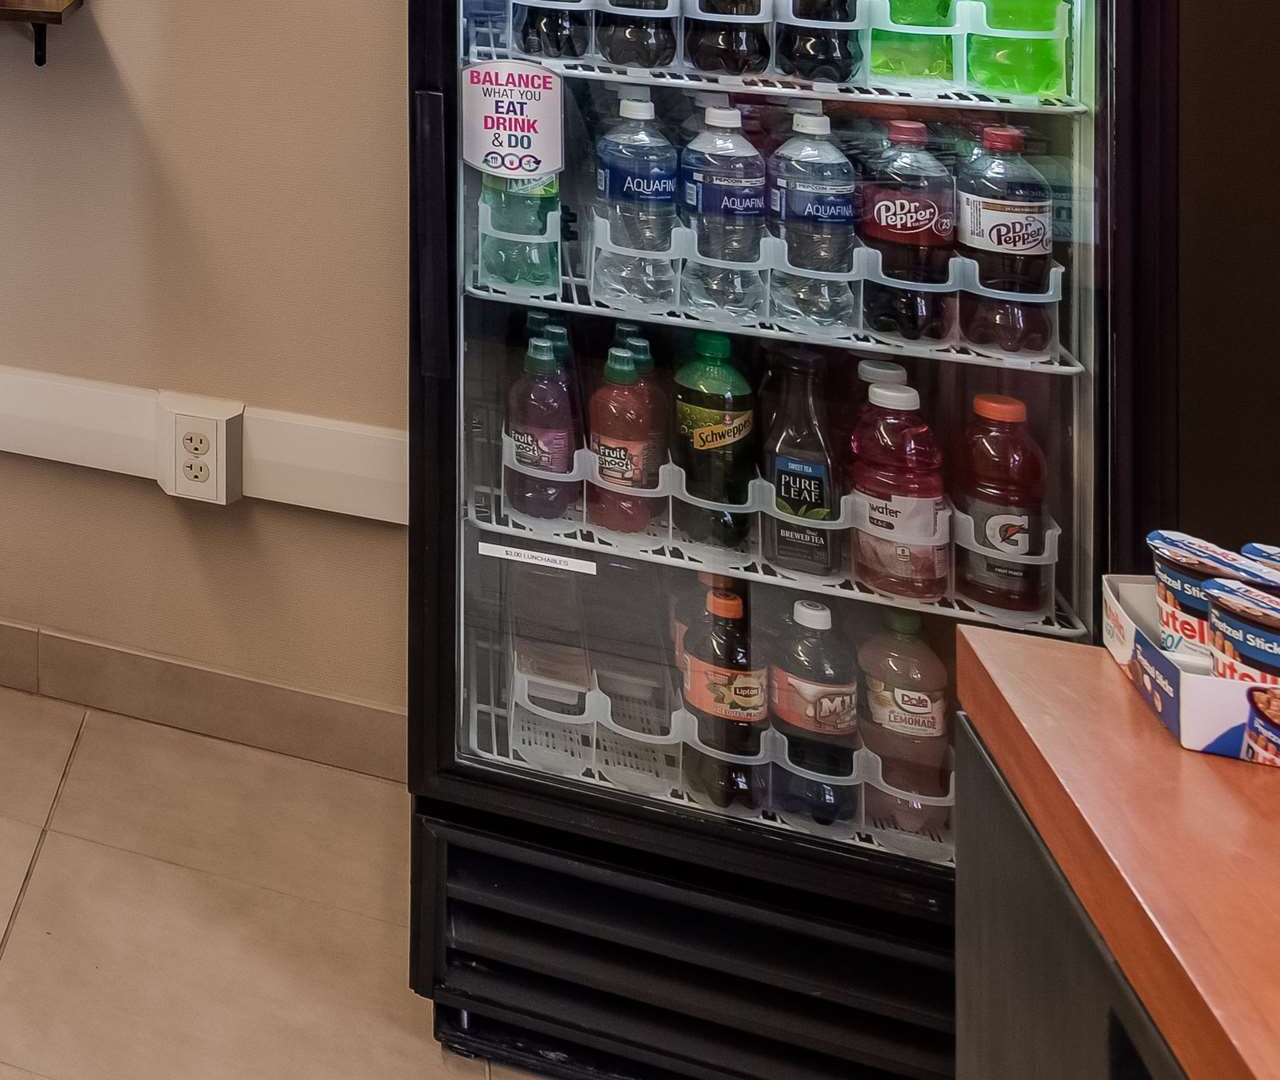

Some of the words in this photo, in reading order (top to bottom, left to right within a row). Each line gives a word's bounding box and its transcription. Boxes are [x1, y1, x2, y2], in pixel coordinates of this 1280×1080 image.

[469, 70, 553, 91] BALANCE
[481, 87, 516, 99] WHAT
[517, 88, 542, 101] YOU
[483, 116, 539, 133] DRINK
[491, 133, 504, 148] &
[507, 134, 532, 149] DO
[895, 199, 920, 213] Dr
[880, 201, 934, 228] Pepper
[996, 223, 1043, 247] Pepper
[1012, 221, 1034, 235] Dr
[600, 446, 626, 459] Fruit
[599, 458, 632, 470] Shoot
[781, 474, 820, 493] PURE
[781, 485, 821, 503] LEAF
[869, 502, 902, 519] water
[780, 529, 810, 540] BREWED
[810, 535, 825, 545] TEA
[985, 514, 1030, 555] G
[736, 687, 759, 697] Lipton
[900, 695, 929, 708] Dole
[888, 713, 937, 730] LEMONADE
